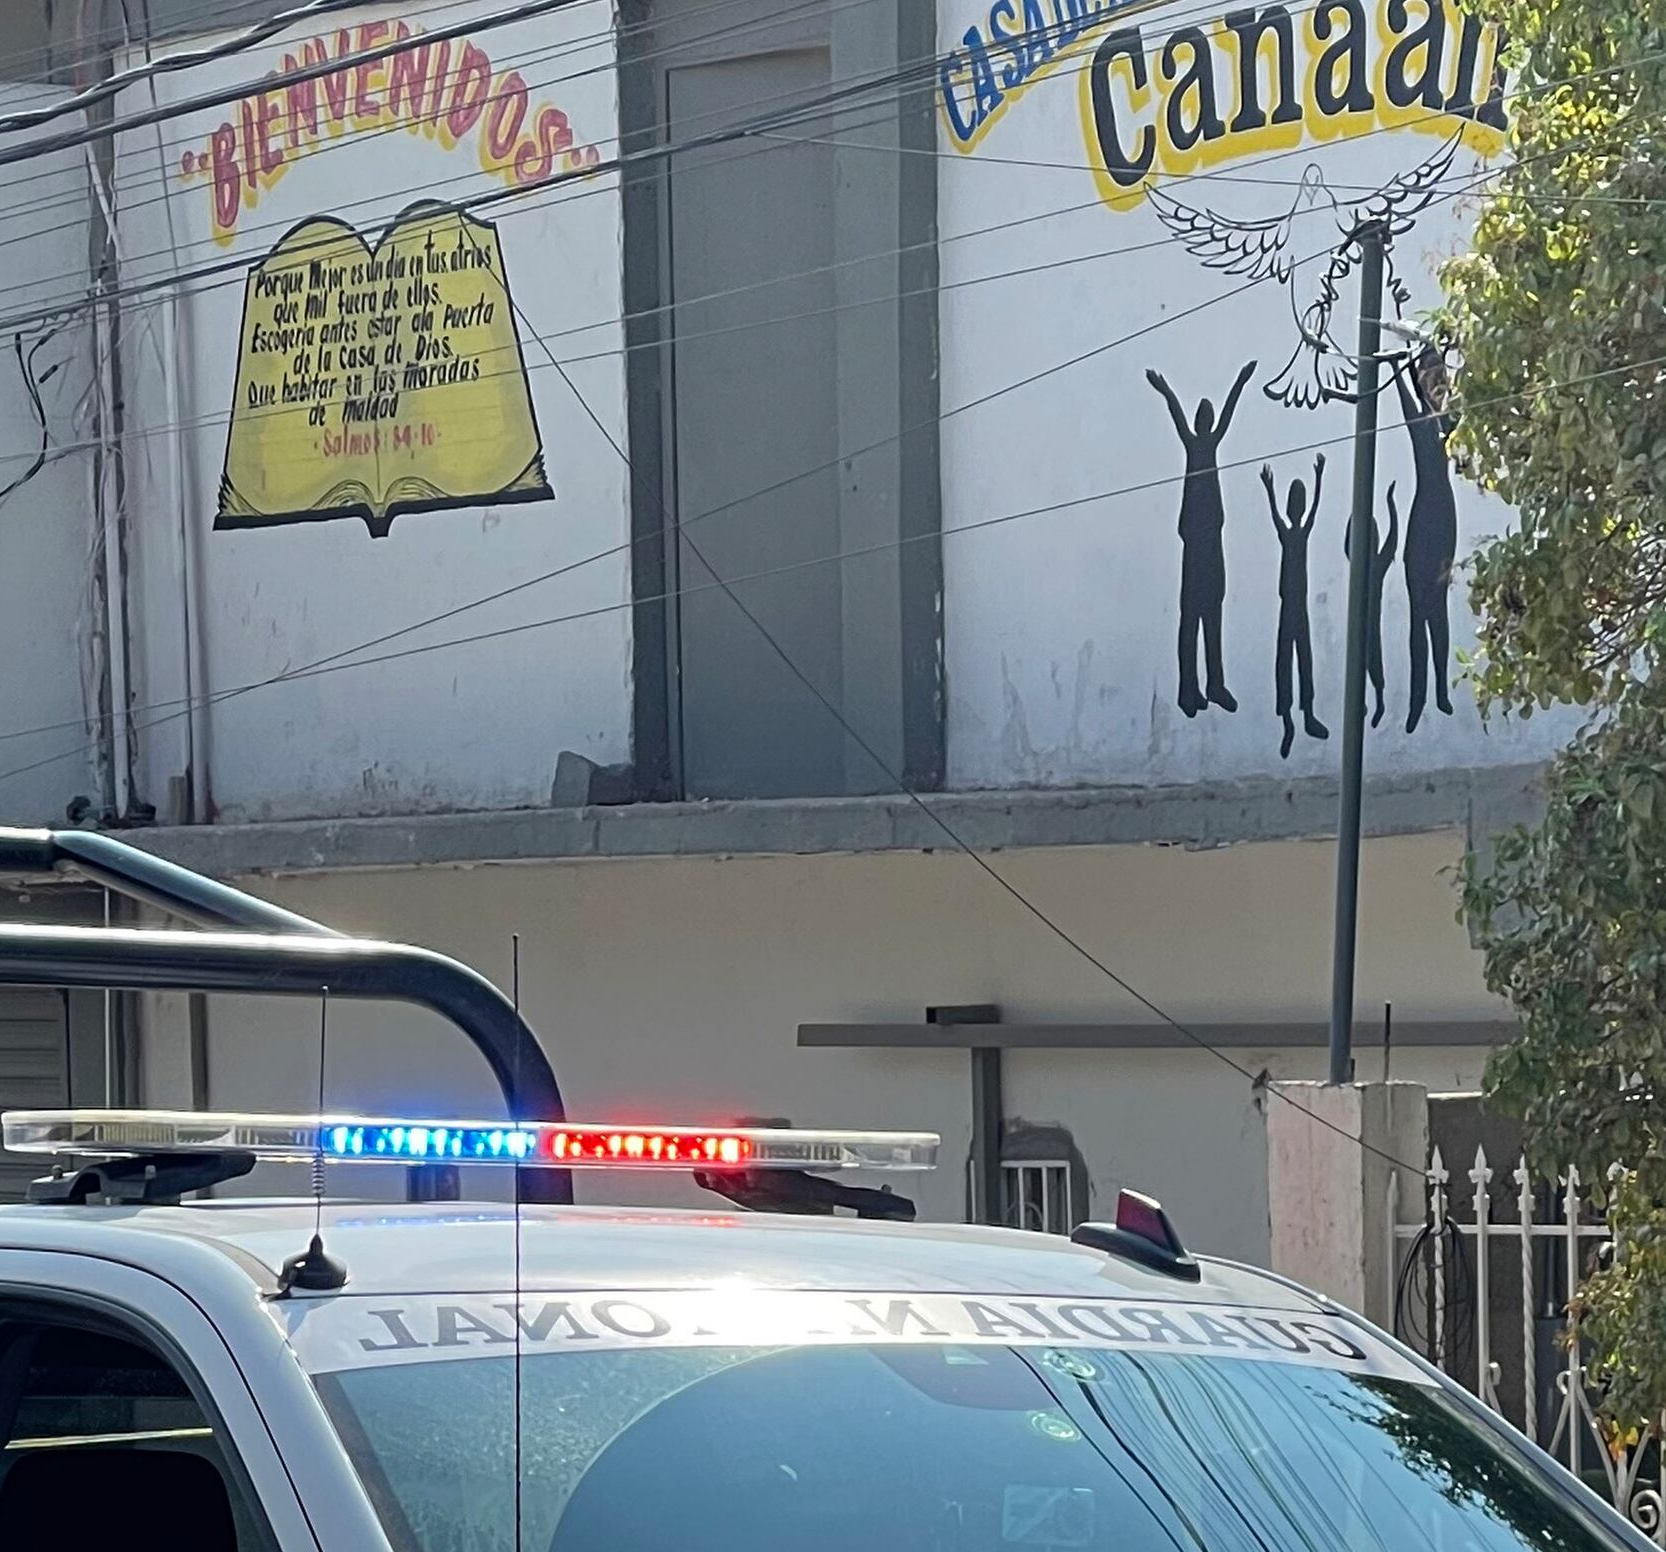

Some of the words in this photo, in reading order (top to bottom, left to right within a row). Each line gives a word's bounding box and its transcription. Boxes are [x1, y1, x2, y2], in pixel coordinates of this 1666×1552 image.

[255, 268, 303, 302] Porque
[351, 263, 364, 286] es
[410, 256, 423, 277] en
[451, 230, 492, 271] atrios
[274, 300, 298, 329] que
[339, 291, 376, 316] fuera
[383, 282, 399, 311] de
[320, 315, 358, 344] antes
[367, 311, 401, 339] estar
[294, 347, 310, 376] de
[318, 344, 331, 373] la
[385, 336, 402, 365] de
[282, 371, 337, 404] habitar
[346, 374, 362, 396] en
[309, 401, 326, 427] de
